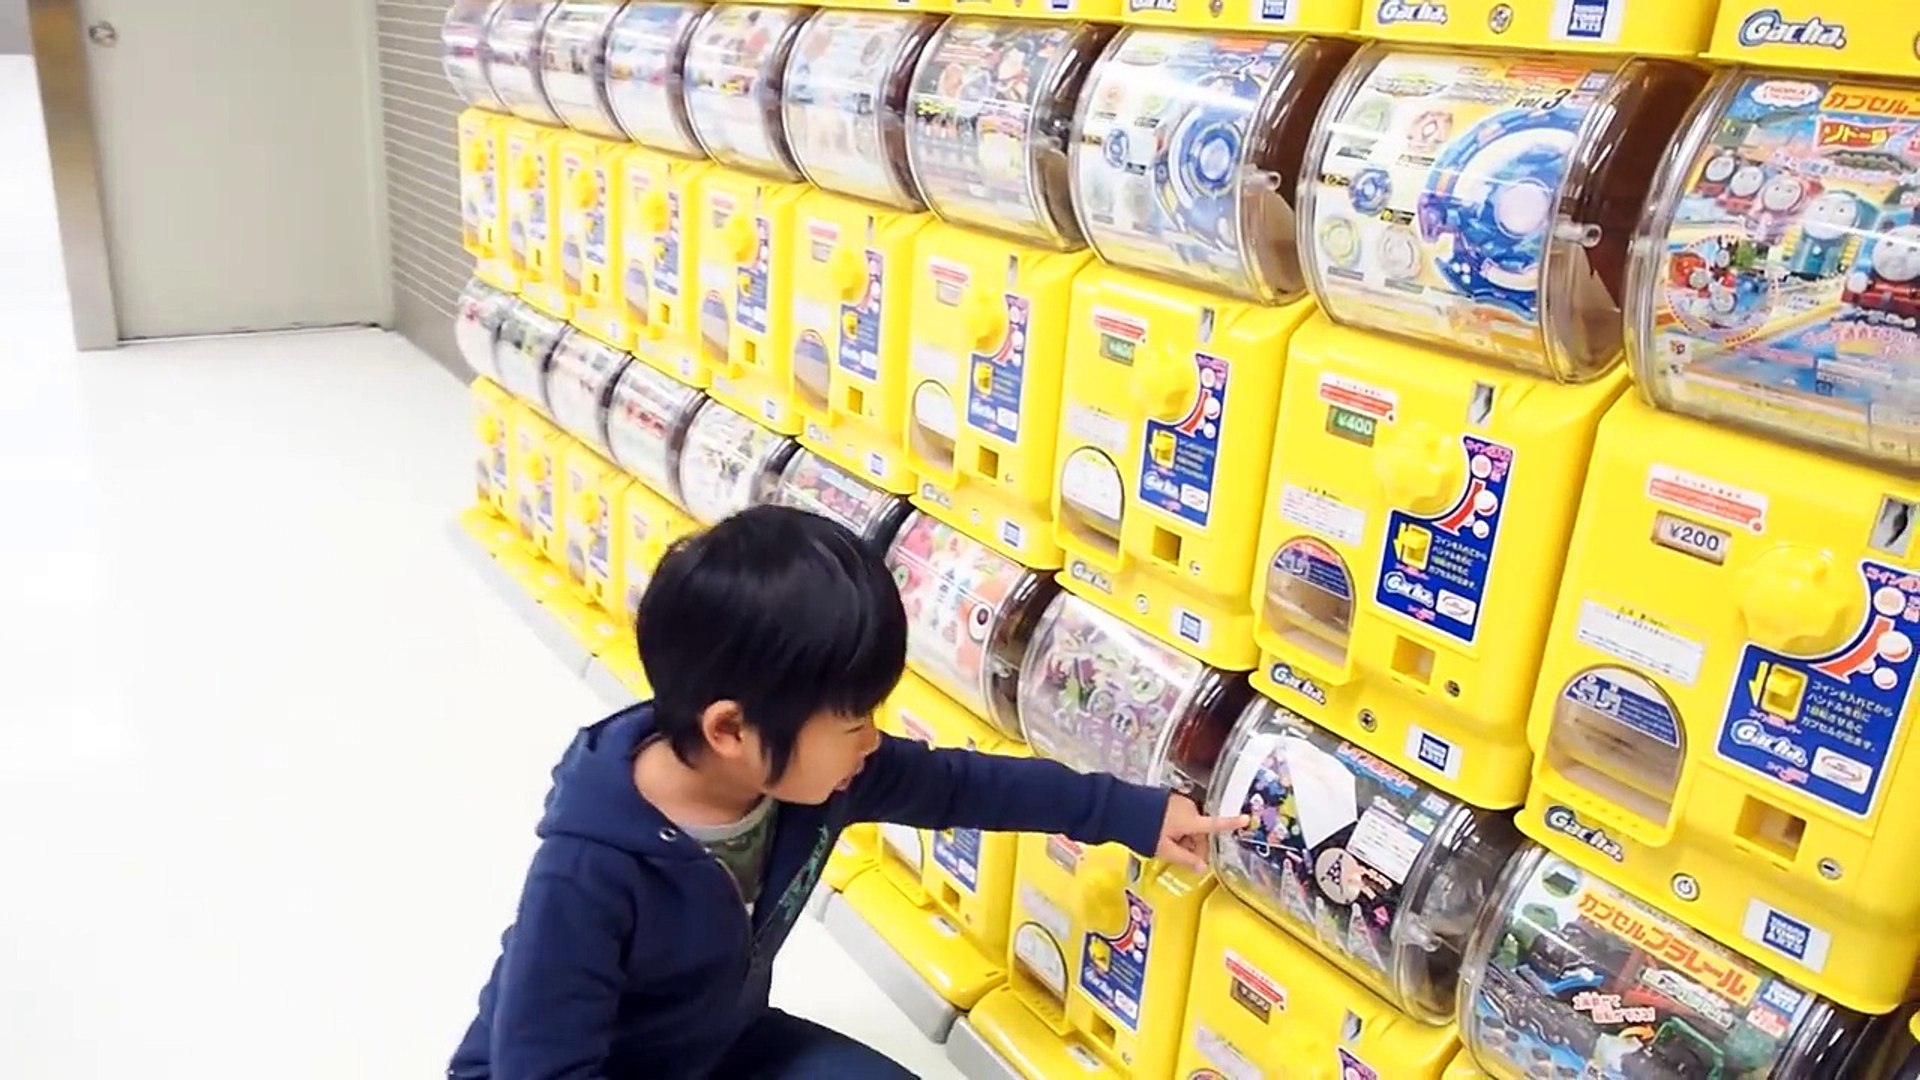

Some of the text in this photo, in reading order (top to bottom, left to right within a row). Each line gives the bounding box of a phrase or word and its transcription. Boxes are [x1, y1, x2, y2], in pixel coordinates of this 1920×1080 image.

[1824, 92, 1919, 116] カプセル
[1668, 523, 1720, 553] ¥200
